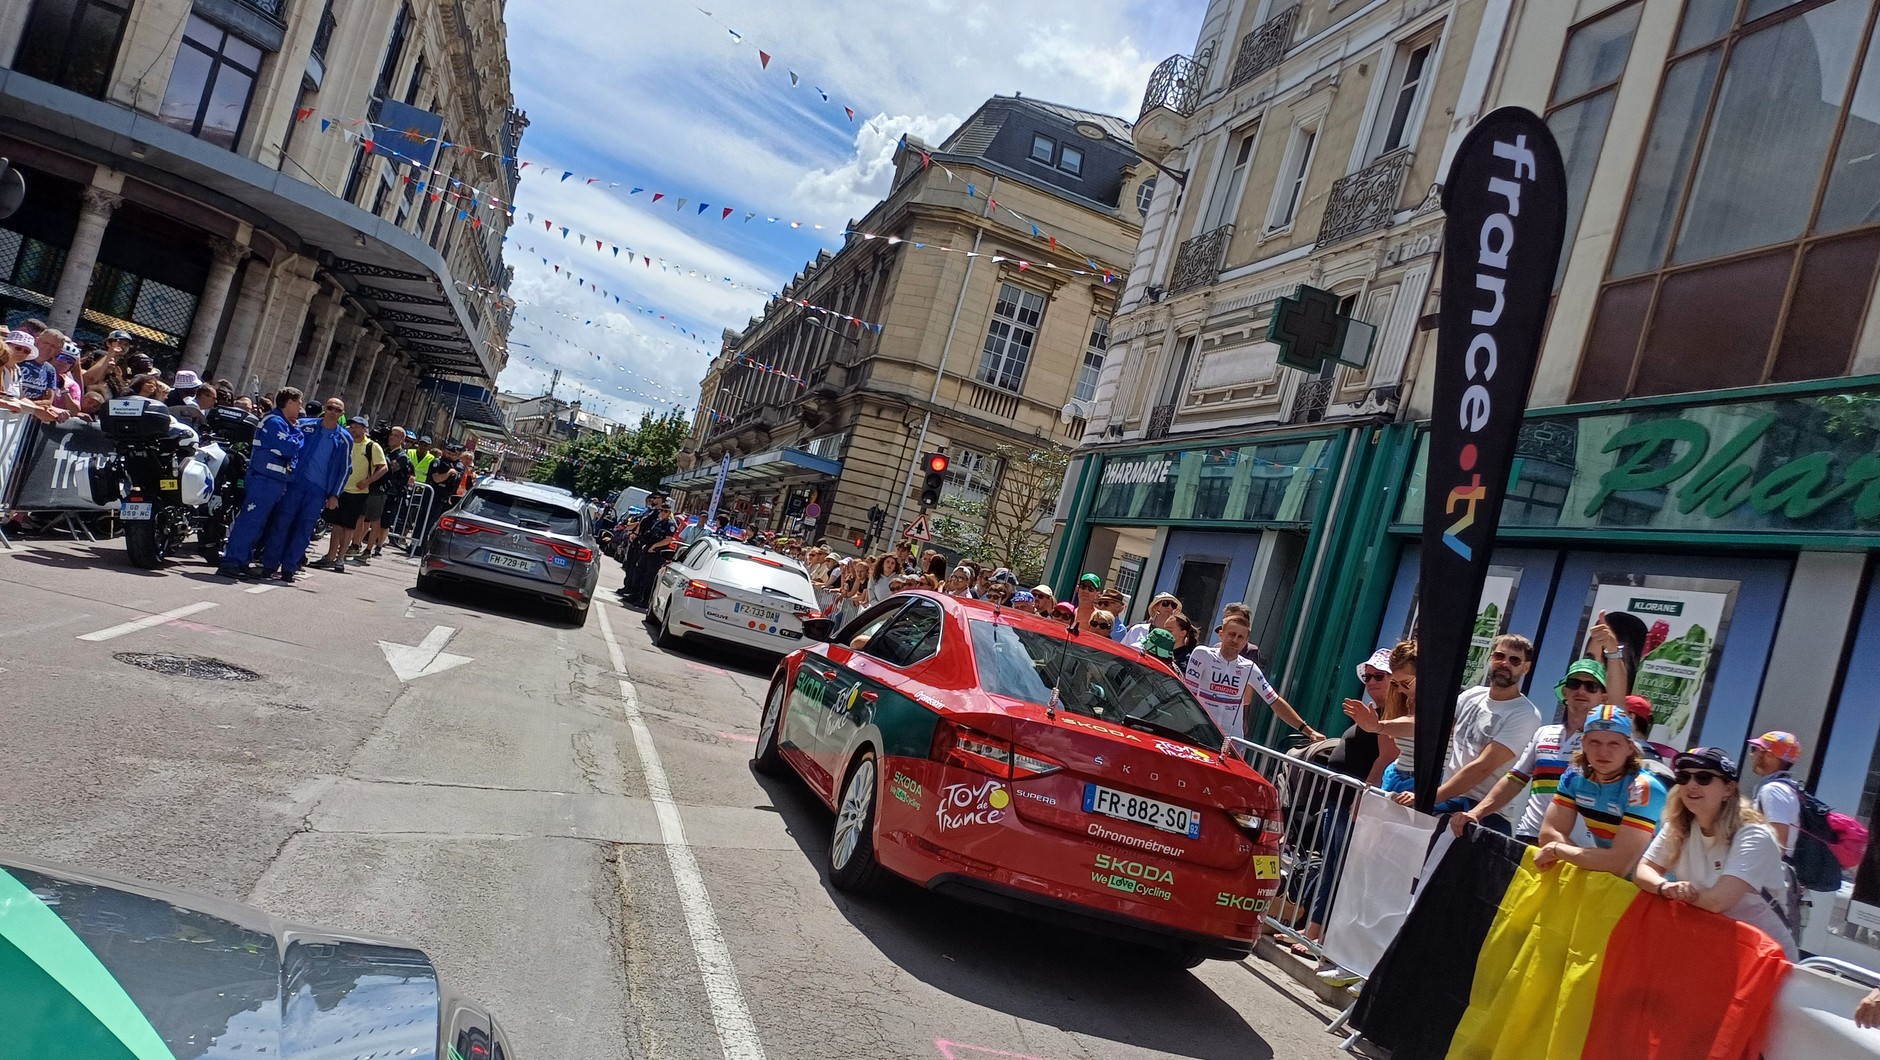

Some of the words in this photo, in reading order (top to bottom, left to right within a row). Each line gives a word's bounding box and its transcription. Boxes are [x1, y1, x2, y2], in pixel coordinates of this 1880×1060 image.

[1459, 134, 1536, 433] france
[1100, 460, 1172, 485] PHARMACIE
[1633, 602, 1678, 613] KLORANE
[1211, 684, 1239, 695] Emirates
[1212, 671, 1240, 688] UAE
[1061, 717, 1142, 742] SKODA
[893, 771, 923, 797] SKODA
[976, 799, 988, 810] de
[1016, 789, 1057, 806] SUPERB
[1097, 789, 1187, 831] FR-882-SQ
[1189, 824, 1198, 834] 92
[1087, 823, 1185, 857] Chronométreur
[1094, 853, 1174, 885] SKODA
[1091, 871, 1108, 884] We
[1136, 883, 1171, 901] Cycling
[1216, 891, 1271, 912] SKODA
